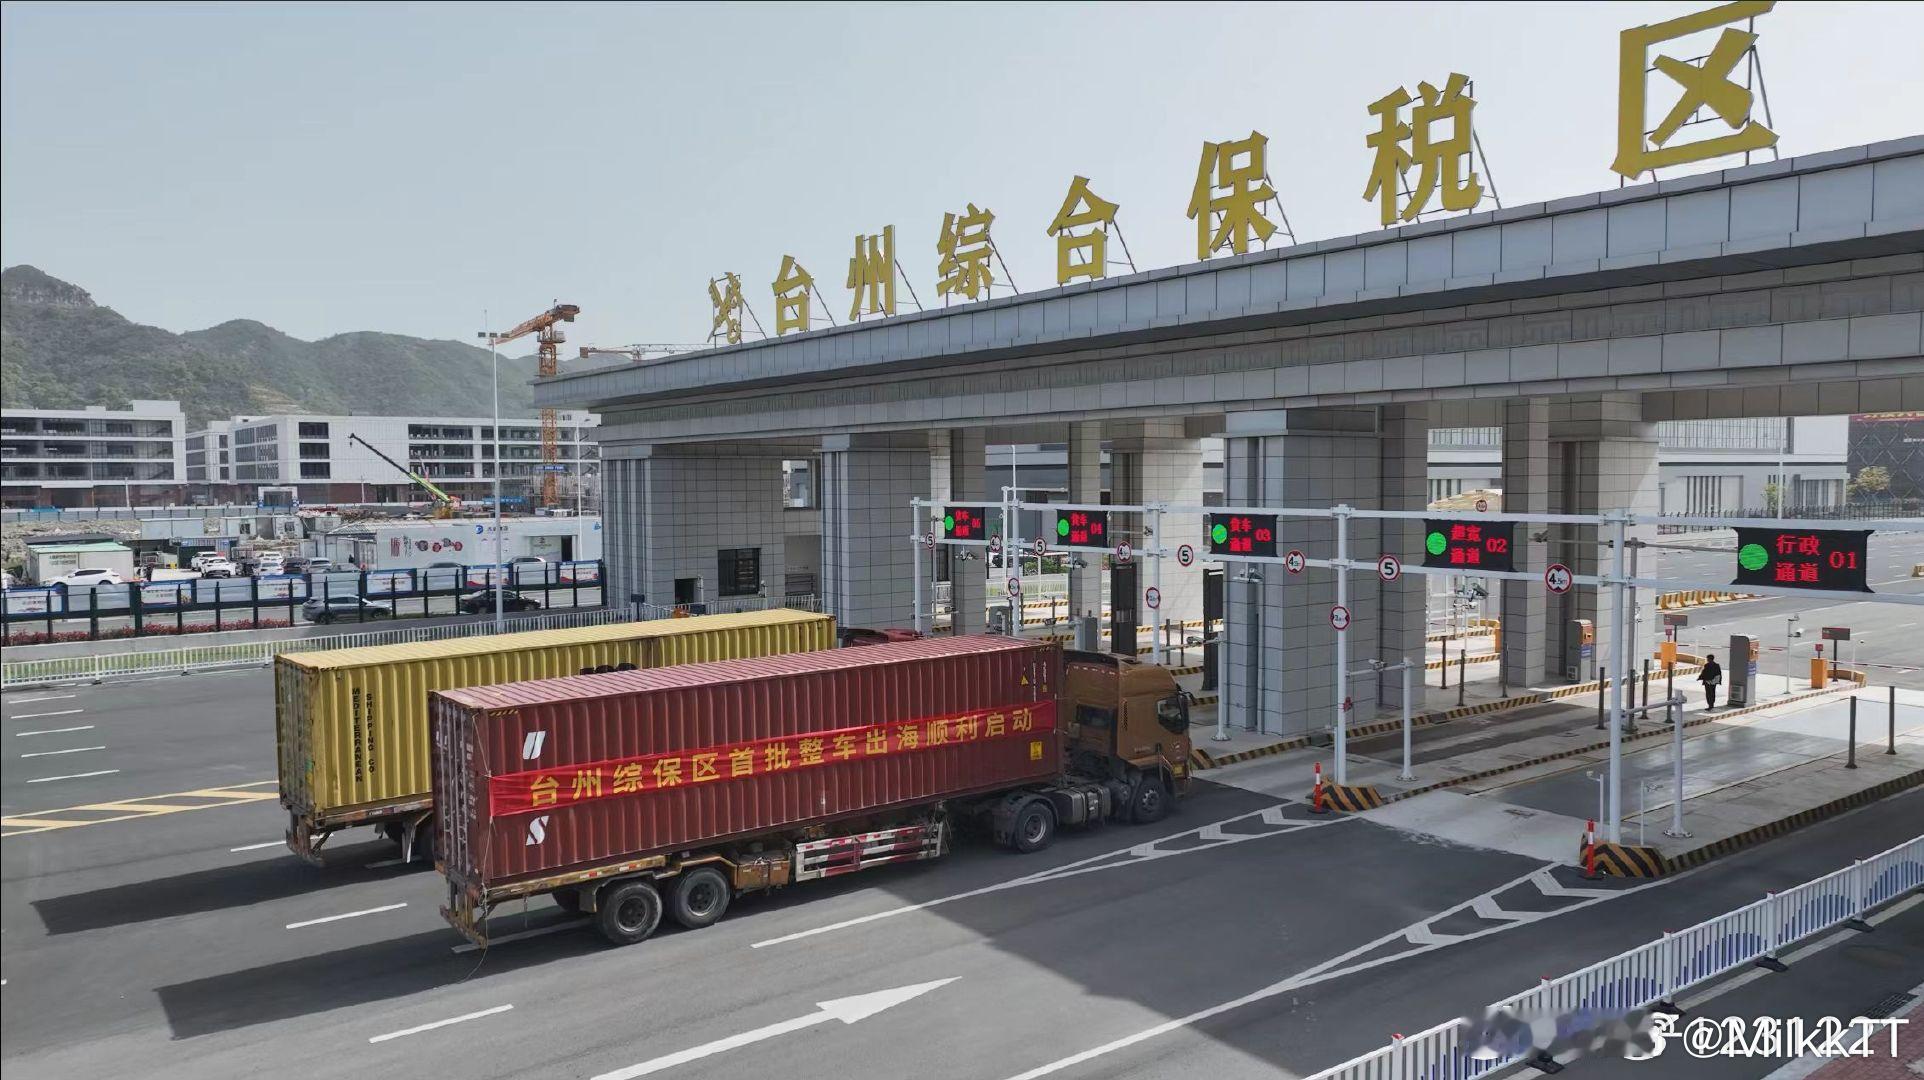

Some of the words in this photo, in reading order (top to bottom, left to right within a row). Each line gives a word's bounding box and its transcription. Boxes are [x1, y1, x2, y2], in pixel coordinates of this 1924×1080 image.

[772, 1, 1779, 336] 台州综合保税区
[1229, 517, 1252, 533] 货车
[1254, 528, 1271, 542] 03
[1037, 541, 1042, 552] 5
[1485, 538, 1508, 554] 02
[1775, 533, 1821, 556] 行政
[1182, 550, 1189, 562] 5
[1450, 547, 1480, 564] 通道
[1828, 551, 1857, 569] 01
[1384, 562, 1394, 575] 5
[1775, 562, 1819, 582] 通道
[366, 693, 374, 751] SHIPPING
[352, 688, 363, 782] MEDITERRANEAN
[529, 707, 1034, 807] 台州综保区首批整车出海顺利启动
